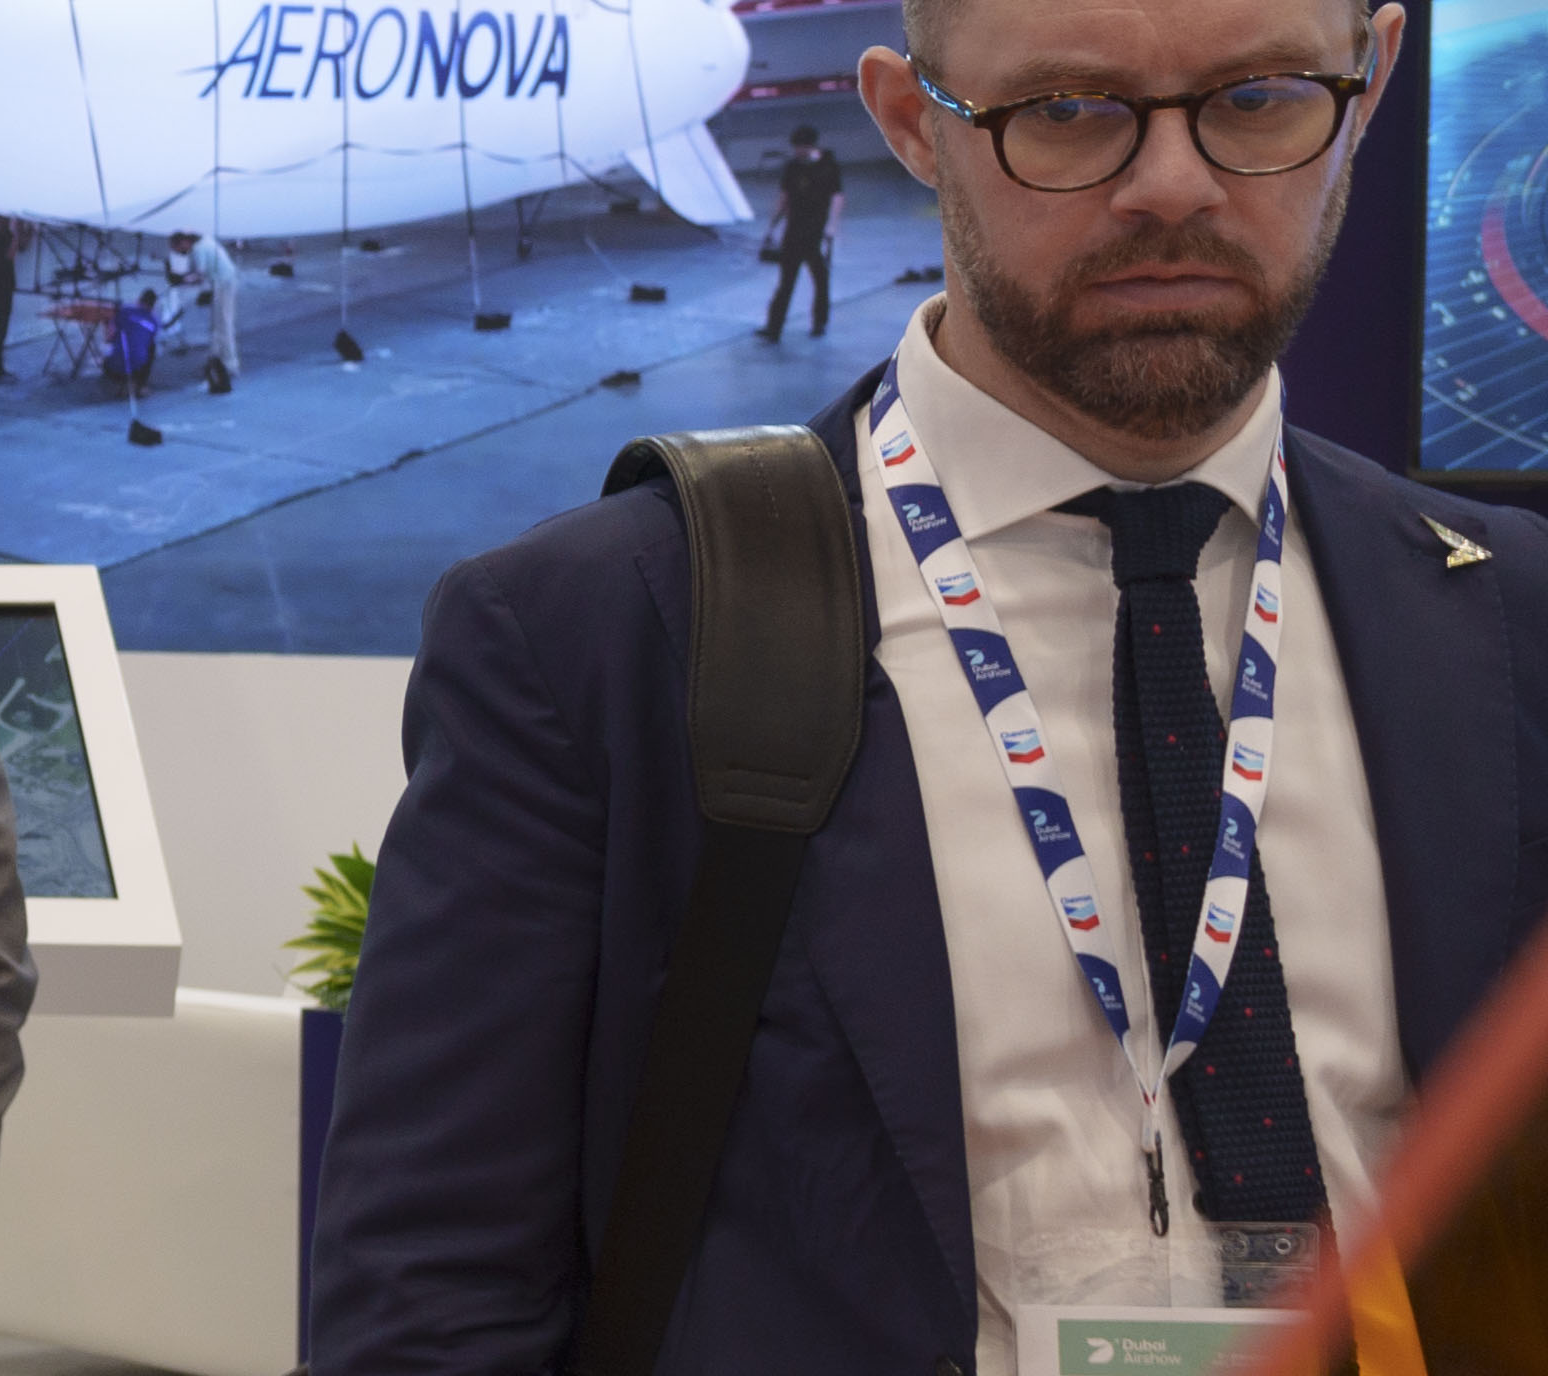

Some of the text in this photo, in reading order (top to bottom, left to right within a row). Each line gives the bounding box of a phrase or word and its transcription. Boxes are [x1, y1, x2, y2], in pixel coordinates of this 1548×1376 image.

[178, 3, 570, 101] AERONOVA
[1122, 1337, 1167, 1352] Dubai
[1123, 1352, 1183, 1366] Airshow
